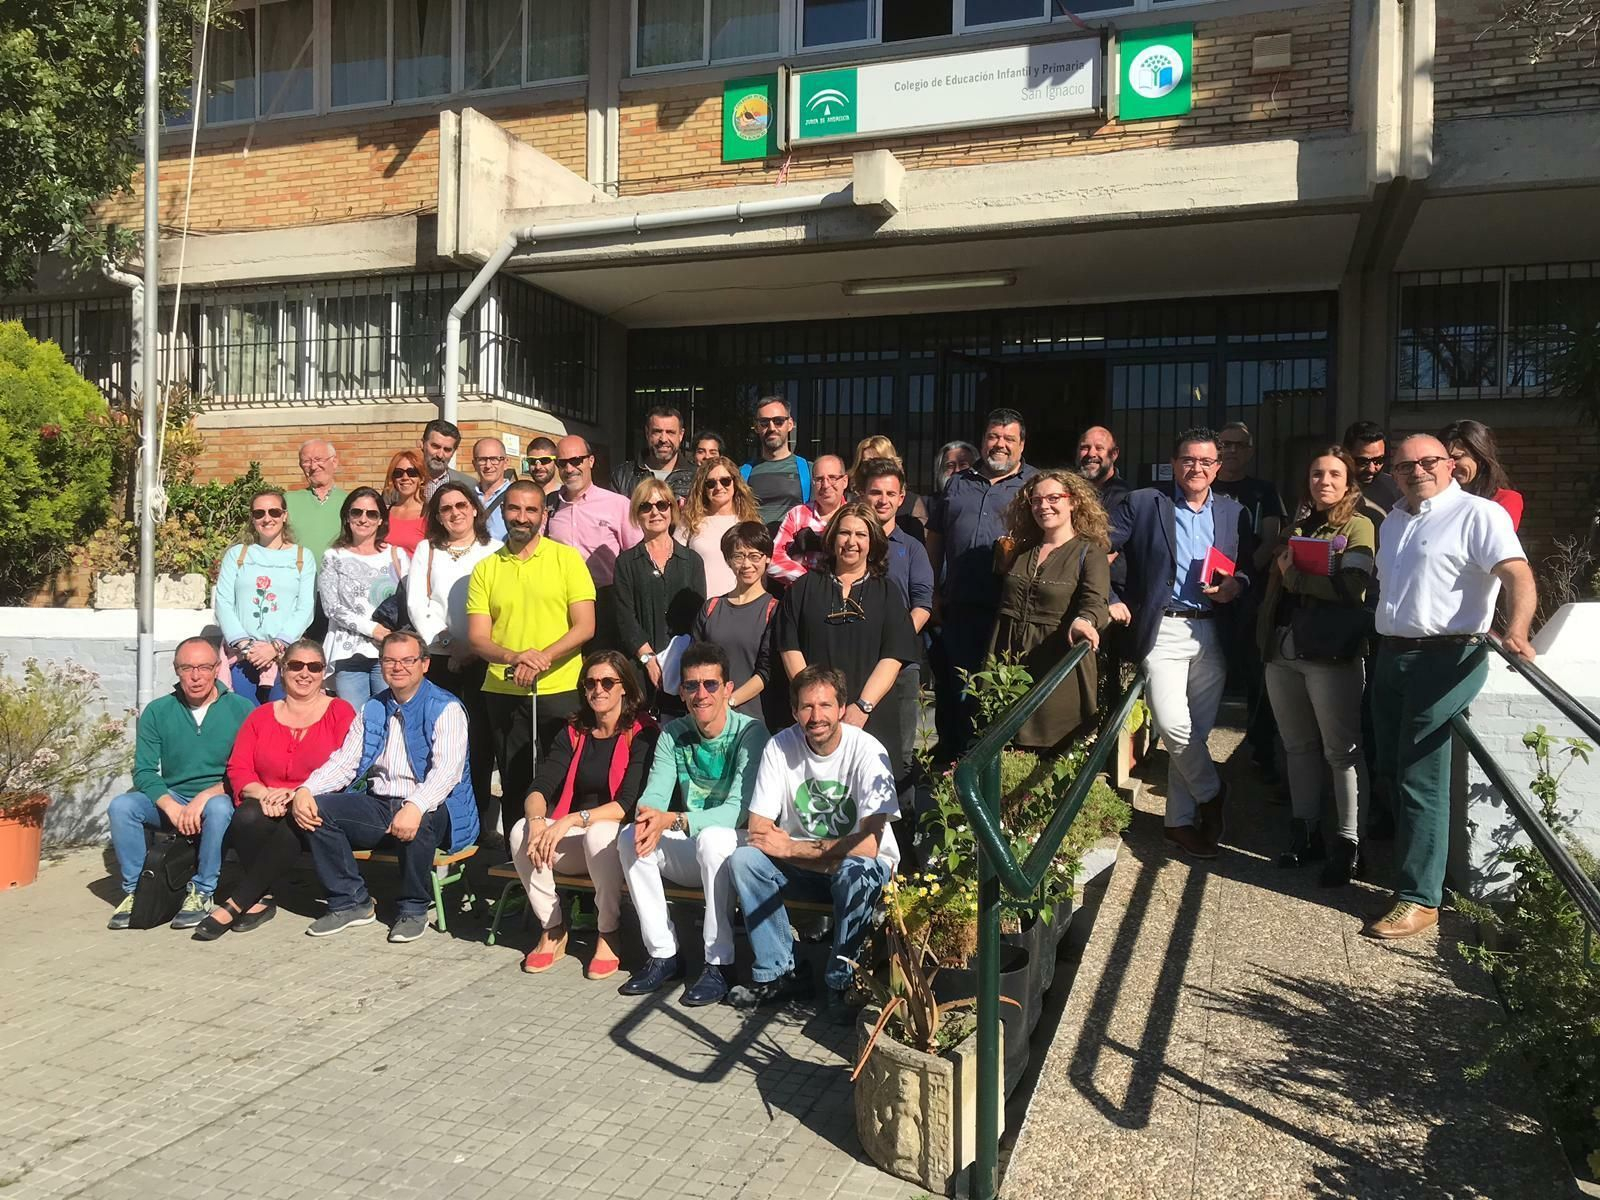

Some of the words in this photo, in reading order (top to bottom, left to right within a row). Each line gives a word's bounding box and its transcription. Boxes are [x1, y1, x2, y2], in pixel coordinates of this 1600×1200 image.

[894, 80, 929, 92] Colegio
[931, 77, 943, 87] de
[945, 71, 994, 86] Educación
[997, 67, 1031, 80] Infantil
[1034, 67, 1040, 77] y
[1042, 60, 1085, 74] Primaria
[1020, 87, 1042, 101] San
[1045, 84, 1085, 101] Ignacio
